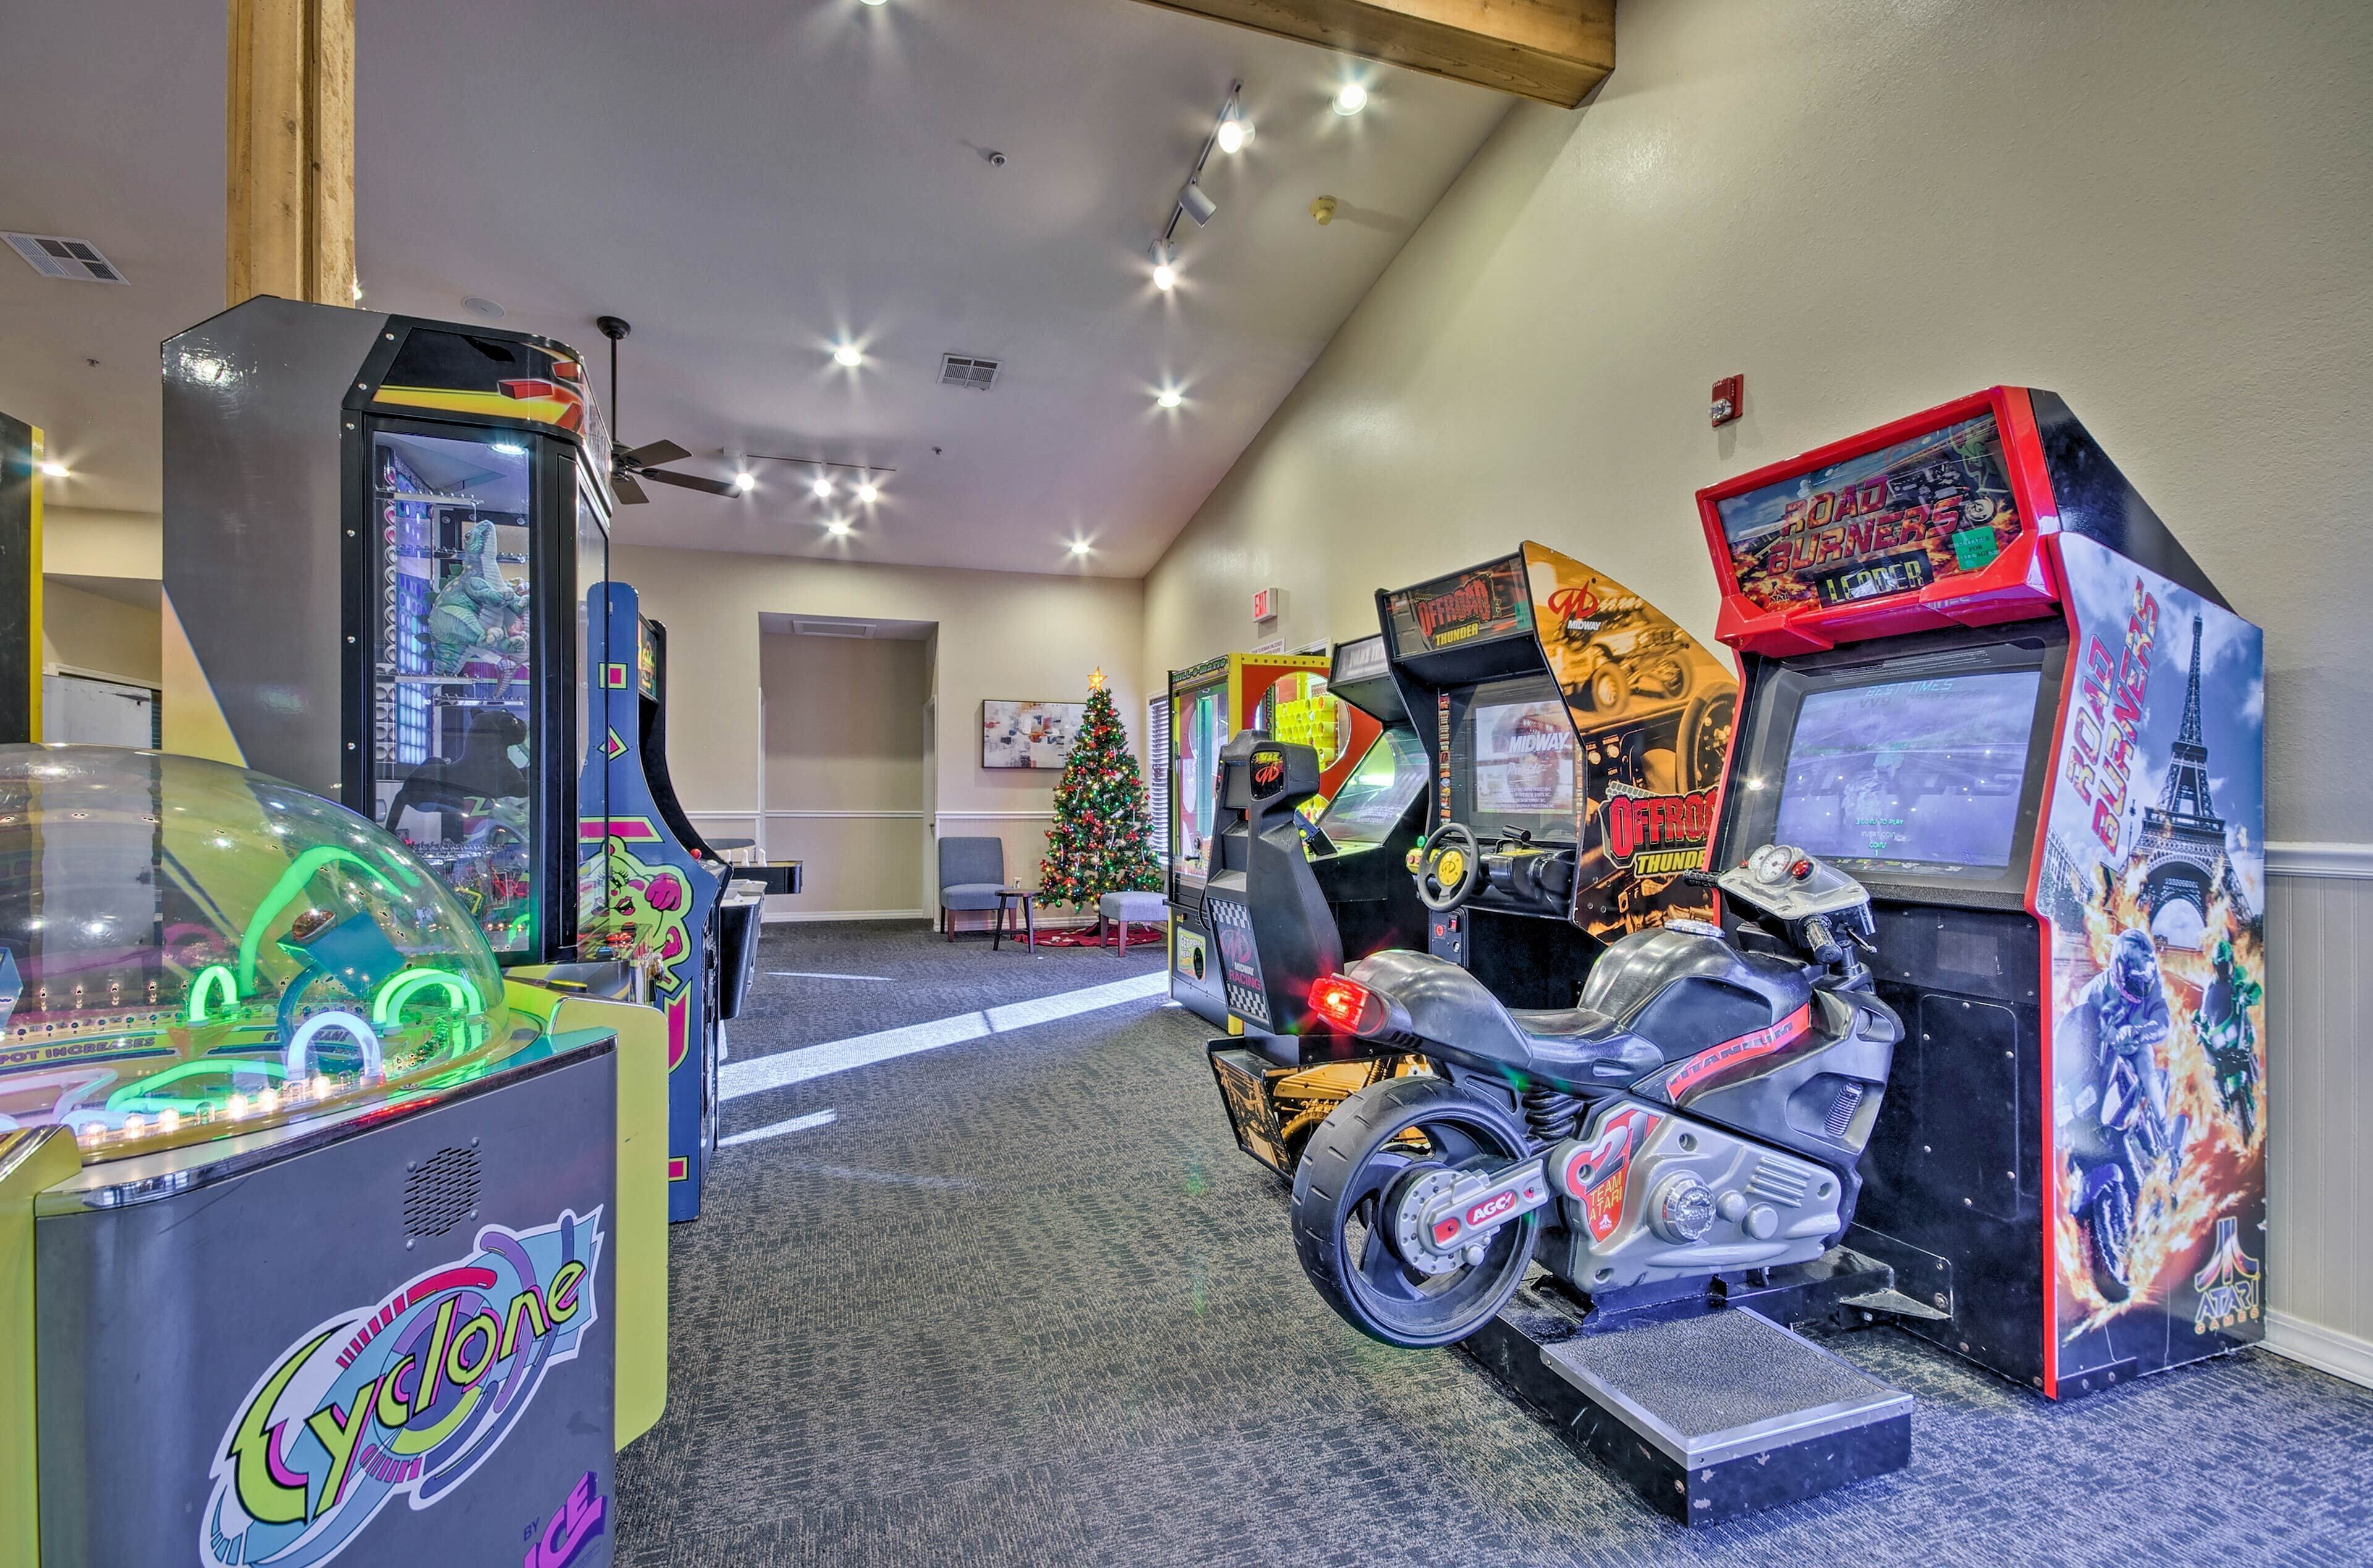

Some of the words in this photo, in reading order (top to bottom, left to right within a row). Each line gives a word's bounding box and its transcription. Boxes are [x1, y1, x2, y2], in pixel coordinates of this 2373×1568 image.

[1782, 474, 1889, 537] ROAD
[1768, 495, 1964, 576] BURNERS
[1958, 535, 1991, 547] SUITABLE
[1826, 560, 1924, 604] LEADER
[1254, 589, 1267, 618] EXIT
[1417, 579, 1491, 638] OFFROAD
[1769, 593, 1789, 604] ATARI
[1435, 622, 1479, 647] THUNDER
[1567, 620, 1601, 631] MIDWAY
[1865, 683, 1905, 698] BEST
[1908, 679, 1955, 694] TIMES
[2066, 633, 2117, 806] ROAD
[2091, 575, 2161, 857] BURNERS
[1508, 731, 1570, 754] MIDWAY
[1610, 788, 1718, 859] OFFRO
[1638, 849, 1706, 875] THUNDE
[1180, 934, 1189, 950] GET
[1229, 969, 1262, 991] RACING
[1234, 961, 1254, 976] MIDWAY
[45, 1037, 155, 1058] INCREASES
[1584, 1112, 1649, 1195] 21
[1589, 1171, 1622, 1207] TEAM
[1588, 1186, 1623, 1225] ATARI
[2194, 1278, 2259, 1323] ATARI
[2194, 1307, 2259, 1335] GAMES
[227, 1259, 588, 1526] Cyclone
[523, 1470, 606, 1568] ICE
[523, 1516, 539, 1542] BY
